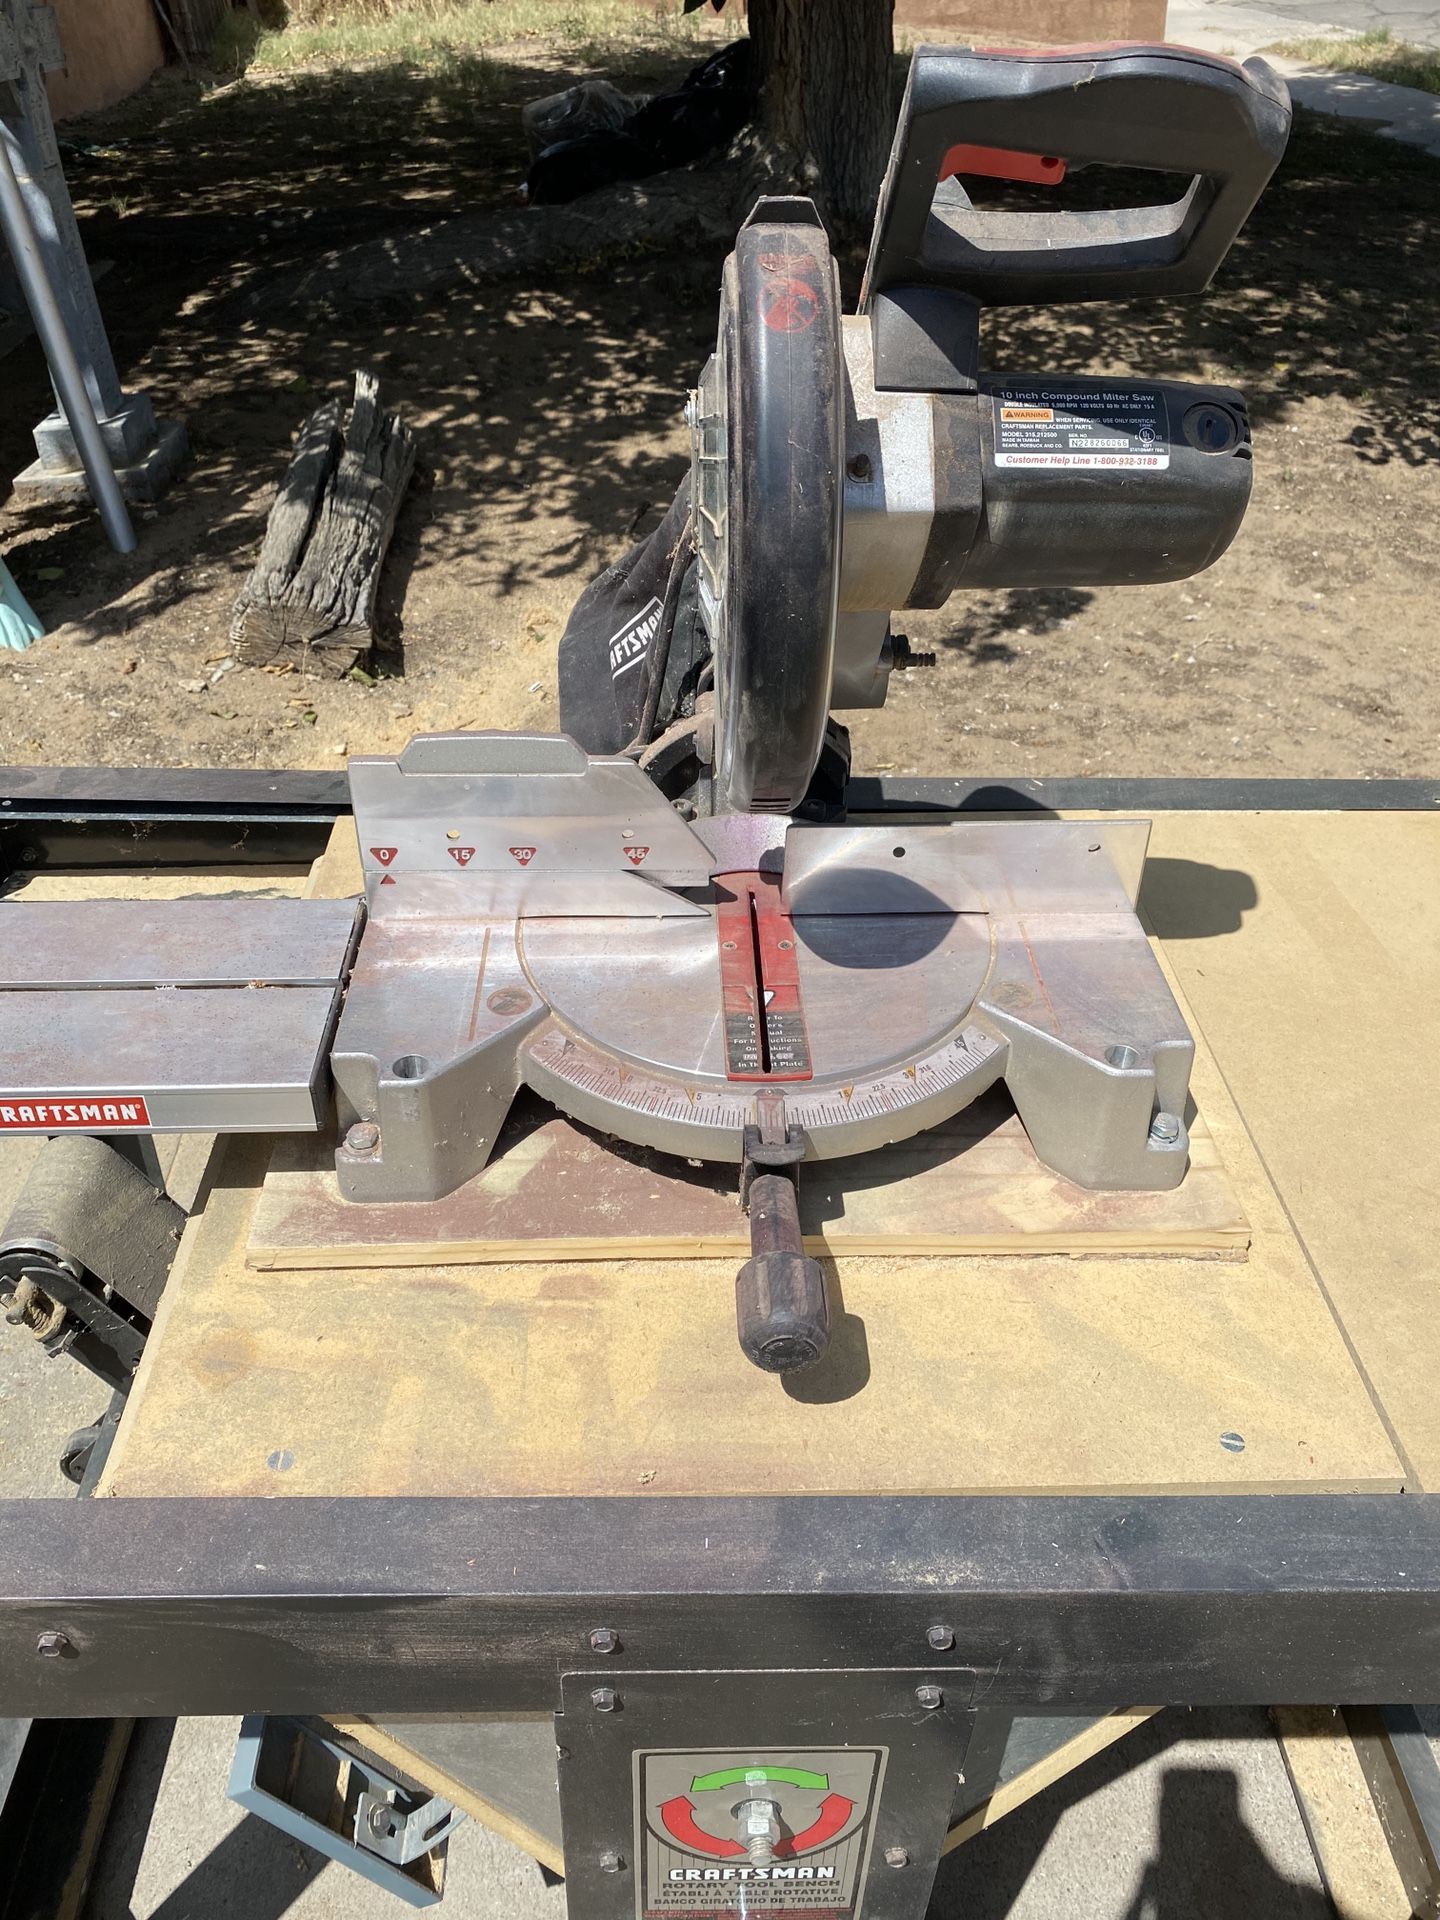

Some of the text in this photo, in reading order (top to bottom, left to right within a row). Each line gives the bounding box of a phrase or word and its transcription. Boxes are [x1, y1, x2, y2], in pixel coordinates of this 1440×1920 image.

[1000, 391, 1012, 399] 10
[1016, 391, 1038, 399] inch
[1041, 392, 1100, 401] Compound
[1132, 393, 1154, 401] Saw
[1006, 455, 1158, 466] Customer Help Line 1-800-932-3188
[609, 606, 664, 671] AFTSMAN
[379, 849, 390, 860] 0
[452, 849, 470, 860] 15
[513, 849, 532, 860] 30
[627, 848, 646, 859] 45
[902, 1068, 915, 1080] 30
[0, 1104, 138, 1122] RAFTSMAN
[669, 1866, 836, 1881] CRAFTSMAN
[783, 1880, 840, 1888] BENCH
[662, 1889, 710, 1897] ÉTABLI
[713, 1889, 722, 1897] À
[773, 1888, 839, 1896] ROTATIVE
[789, 1896, 846, 1904] TRABAJO
